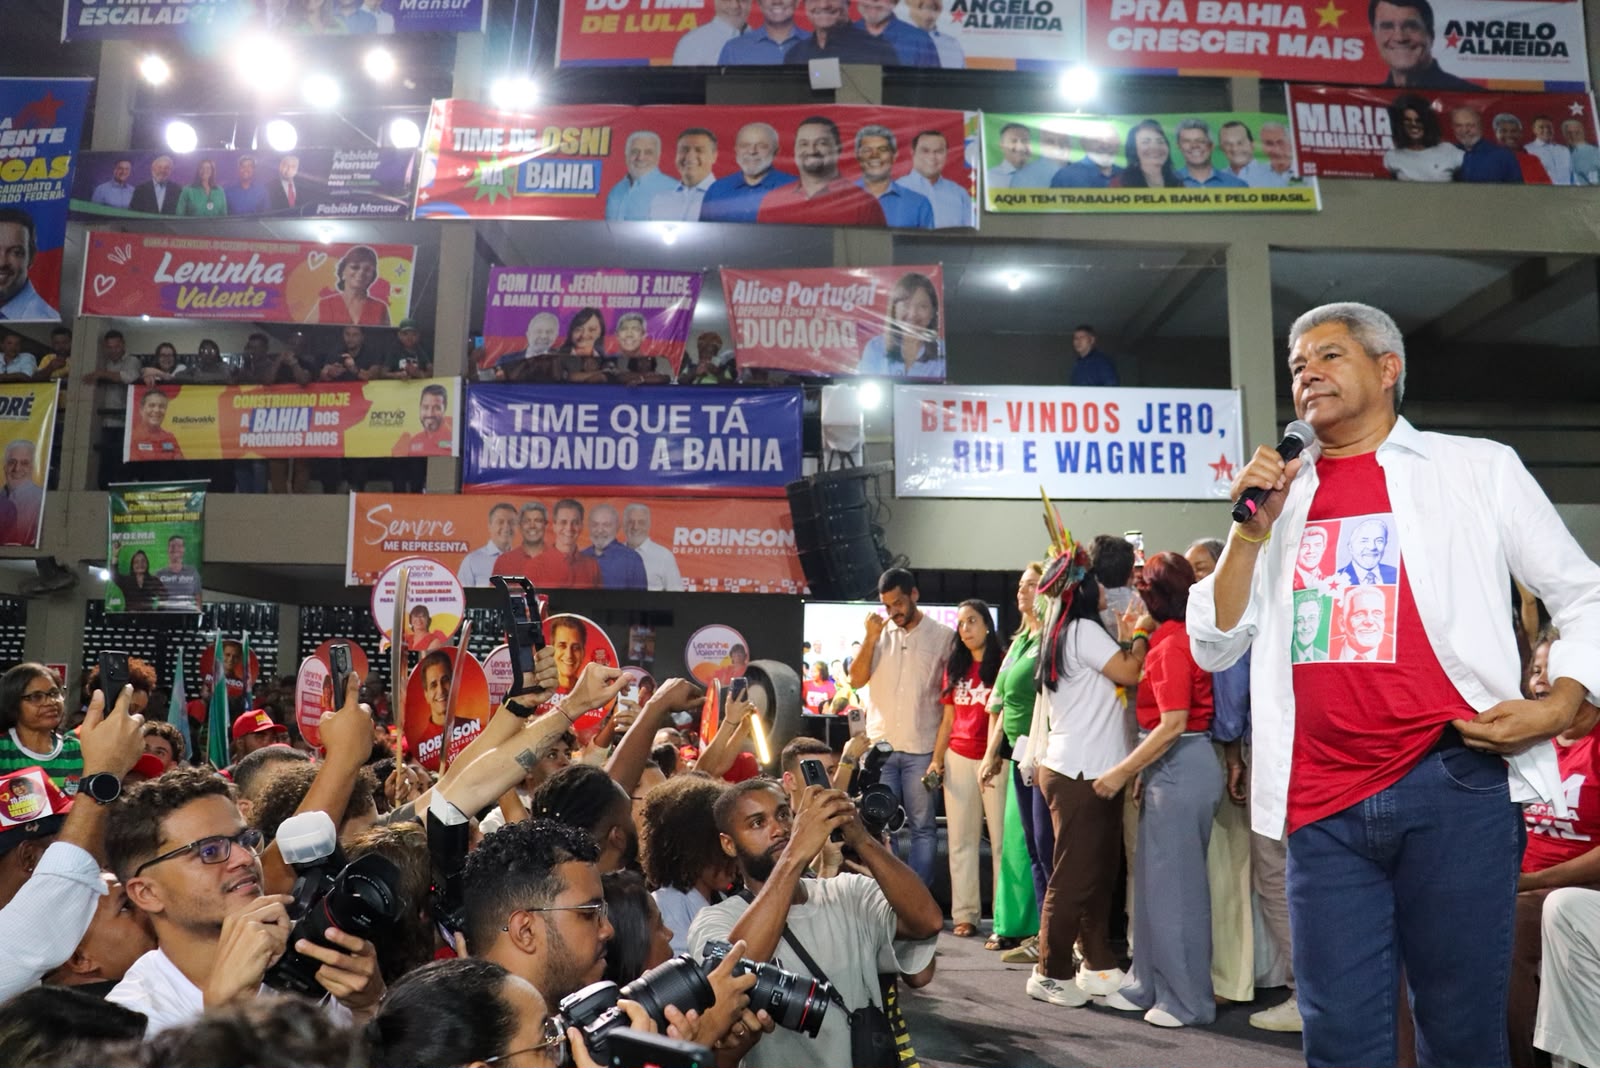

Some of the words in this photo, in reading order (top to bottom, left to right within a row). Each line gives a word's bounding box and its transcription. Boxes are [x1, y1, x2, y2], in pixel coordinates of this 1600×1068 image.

[950, 0, 1054, 16] ANGELO
[1110, 0, 1188, 23] PRA
[1196, 1, 1307, 28] BAHIA
[580, 14, 620, 34] DE
[623, 12, 697, 33] LULA
[963, 14, 1063, 31] ALMEIDA
[1443, 20, 1557, 40] ANGELO
[1106, 26, 1270, 54] CRESCER
[1276, 33, 1365, 61] MAIS
[1458, 38, 1569, 57] ALMEIDA
[1295, 102, 1392, 135] MARIA
[0, 128, 67, 146] ENTE
[452, 127, 505, 152] TIME
[542, 125, 612, 156] OSNI
[0, 155, 72, 182] CAS
[525, 163, 594, 190] BAHIA
[360, 202, 400, 212] Mansur
[994, 194, 1026, 205] AQUI
[1029, 194, 1057, 204] TEM
[1060, 194, 1131, 204] TRABALHO
[1134, 194, 1167, 204] PELA
[1169, 194, 1212, 204] BAHIA
[1214, 194, 1222, 203] E
[1225, 193, 1258, 203] PELO
[153, 251, 286, 285] Leninha
[497, 273, 528, 293] COM
[641, 275, 650, 294] E
[175, 285, 267, 310] Valente
[491, 294, 500, 307] A
[503, 294, 539, 307] BAHIA
[732, 278, 783, 305] Alice
[785, 278, 880, 312] Portugal
[319, 392, 350, 406] HOJE
[240, 413, 250, 427] A
[252, 406, 309, 432] BAHIA
[314, 411, 340, 425] DOS
[508, 404, 599, 433] TIME
[610, 404, 691, 437] QUE
[702, 397, 749, 434] TÁ
[921, 399, 1120, 433] BEM-VINDOS
[1137, 402, 1226, 439] JERO,
[304, 431, 339, 446] ANOS
[480, 436, 639, 470] MUDANDO
[650, 437, 672, 470] A
[683, 437, 784, 471] BAHIA
[953, 440, 1004, 473] RUI
[1023, 440, 1037, 473] E
[1055, 440, 1187, 474] WAGNER
[364, 503, 456, 545] Sempre
[383, 540, 400, 551] ME
[401, 541, 469, 552] REPRESENTA
[673, 527, 795, 547] ROBINSON
[672, 547, 732, 555] DEPUTADO
[693, 641, 729, 649] Leninha
